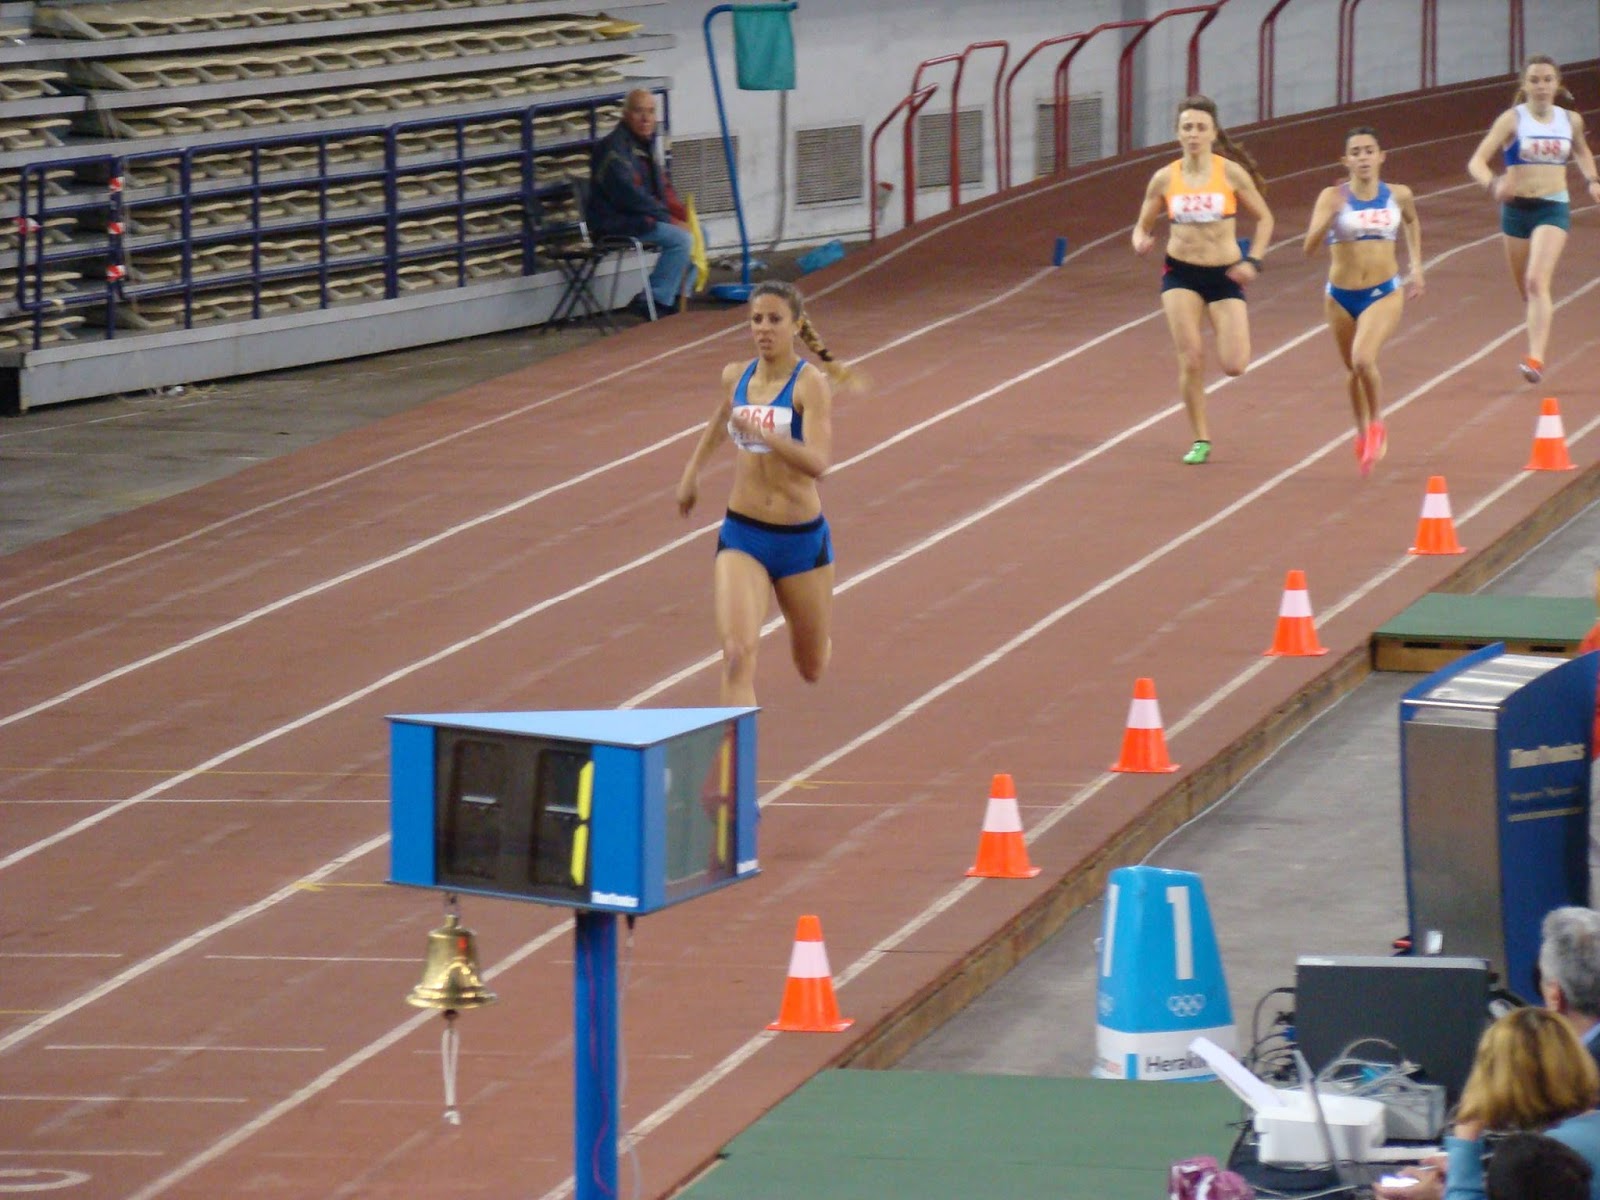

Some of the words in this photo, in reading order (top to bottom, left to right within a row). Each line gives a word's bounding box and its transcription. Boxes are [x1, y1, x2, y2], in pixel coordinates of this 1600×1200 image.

[1182, 193, 1212, 213] 224
[1358, 209, 1391, 228] 143
[1166, 886, 1194, 980] 1
